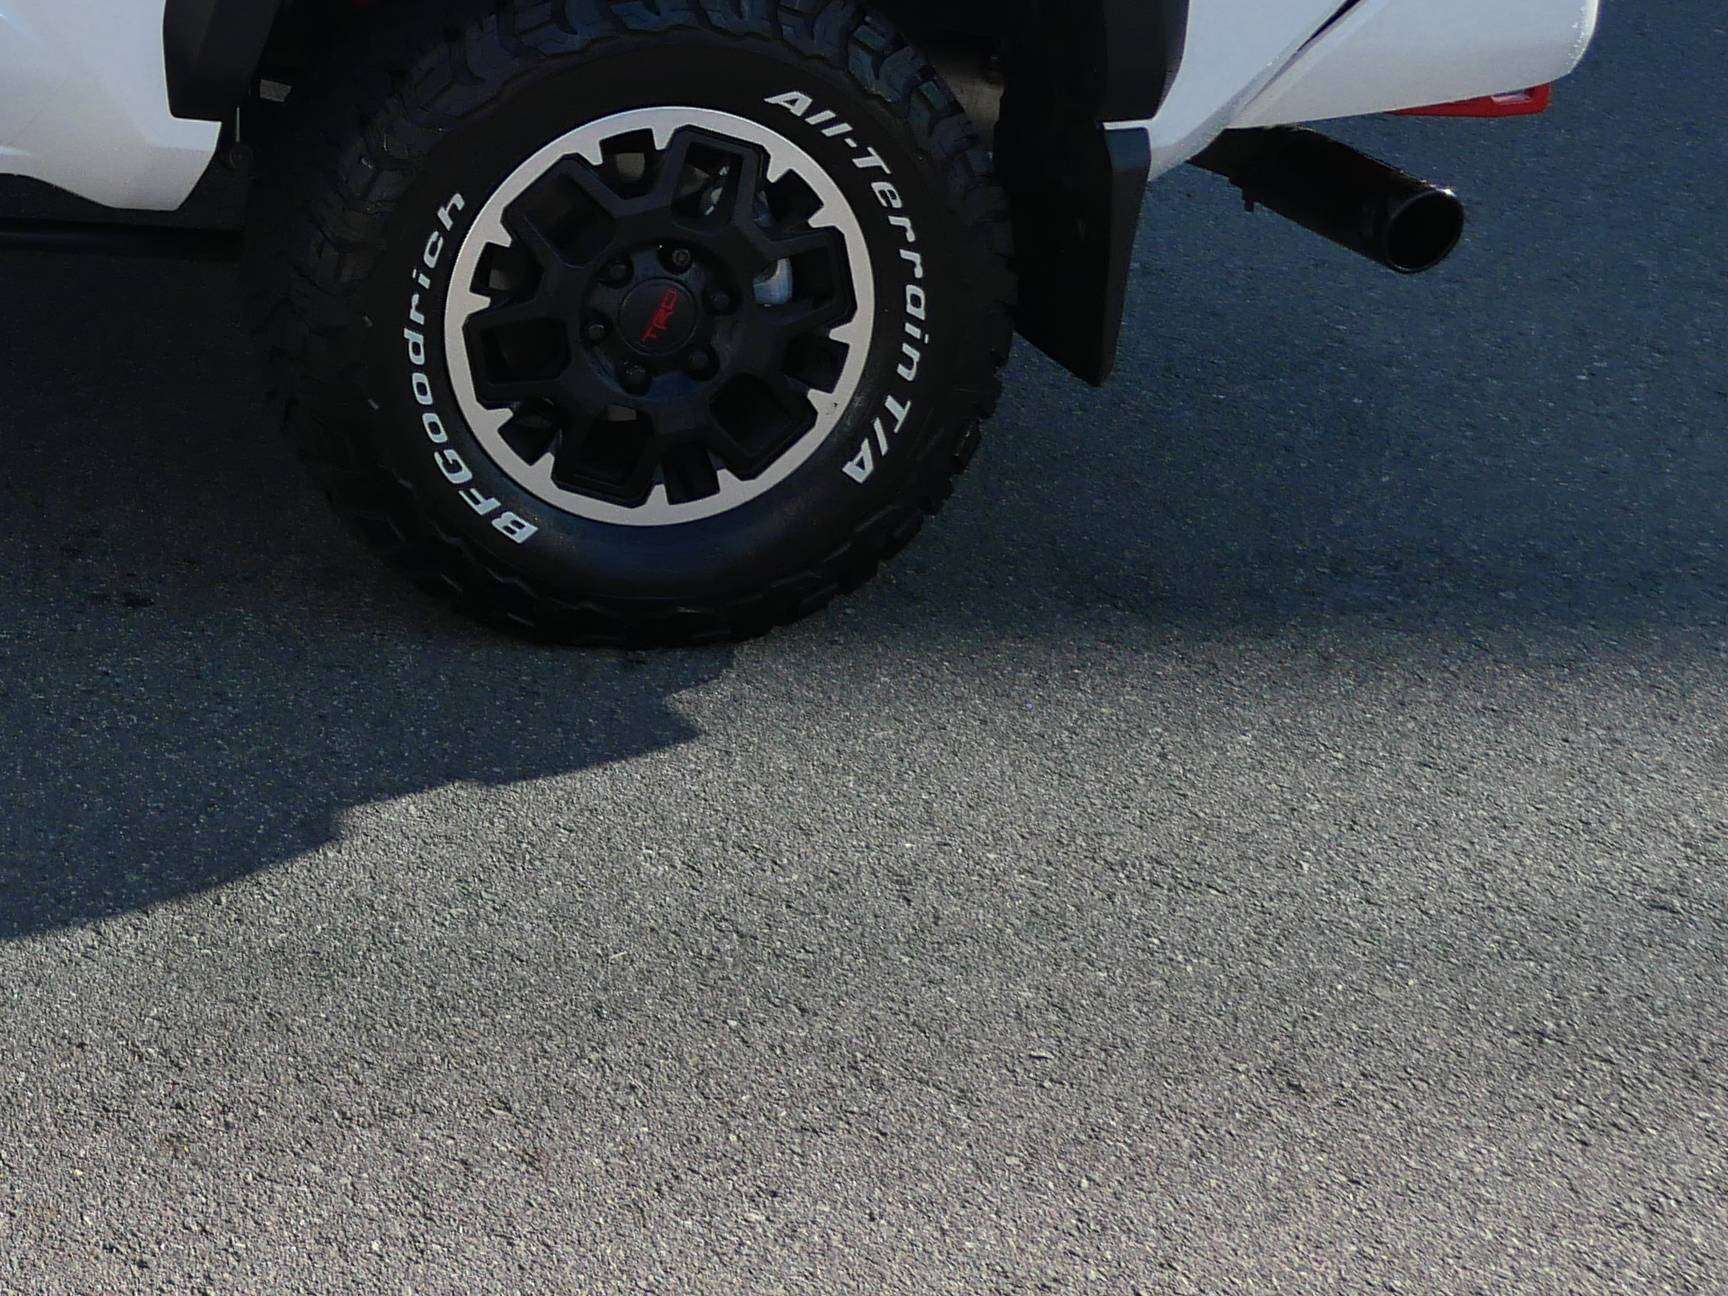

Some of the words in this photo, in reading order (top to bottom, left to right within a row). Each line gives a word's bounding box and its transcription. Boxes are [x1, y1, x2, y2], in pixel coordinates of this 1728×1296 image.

[403, 192, 539, 544] BFGoodrich
[764, 89, 930, 382] All-Terrain
[842, 395, 913, 483] T/A
